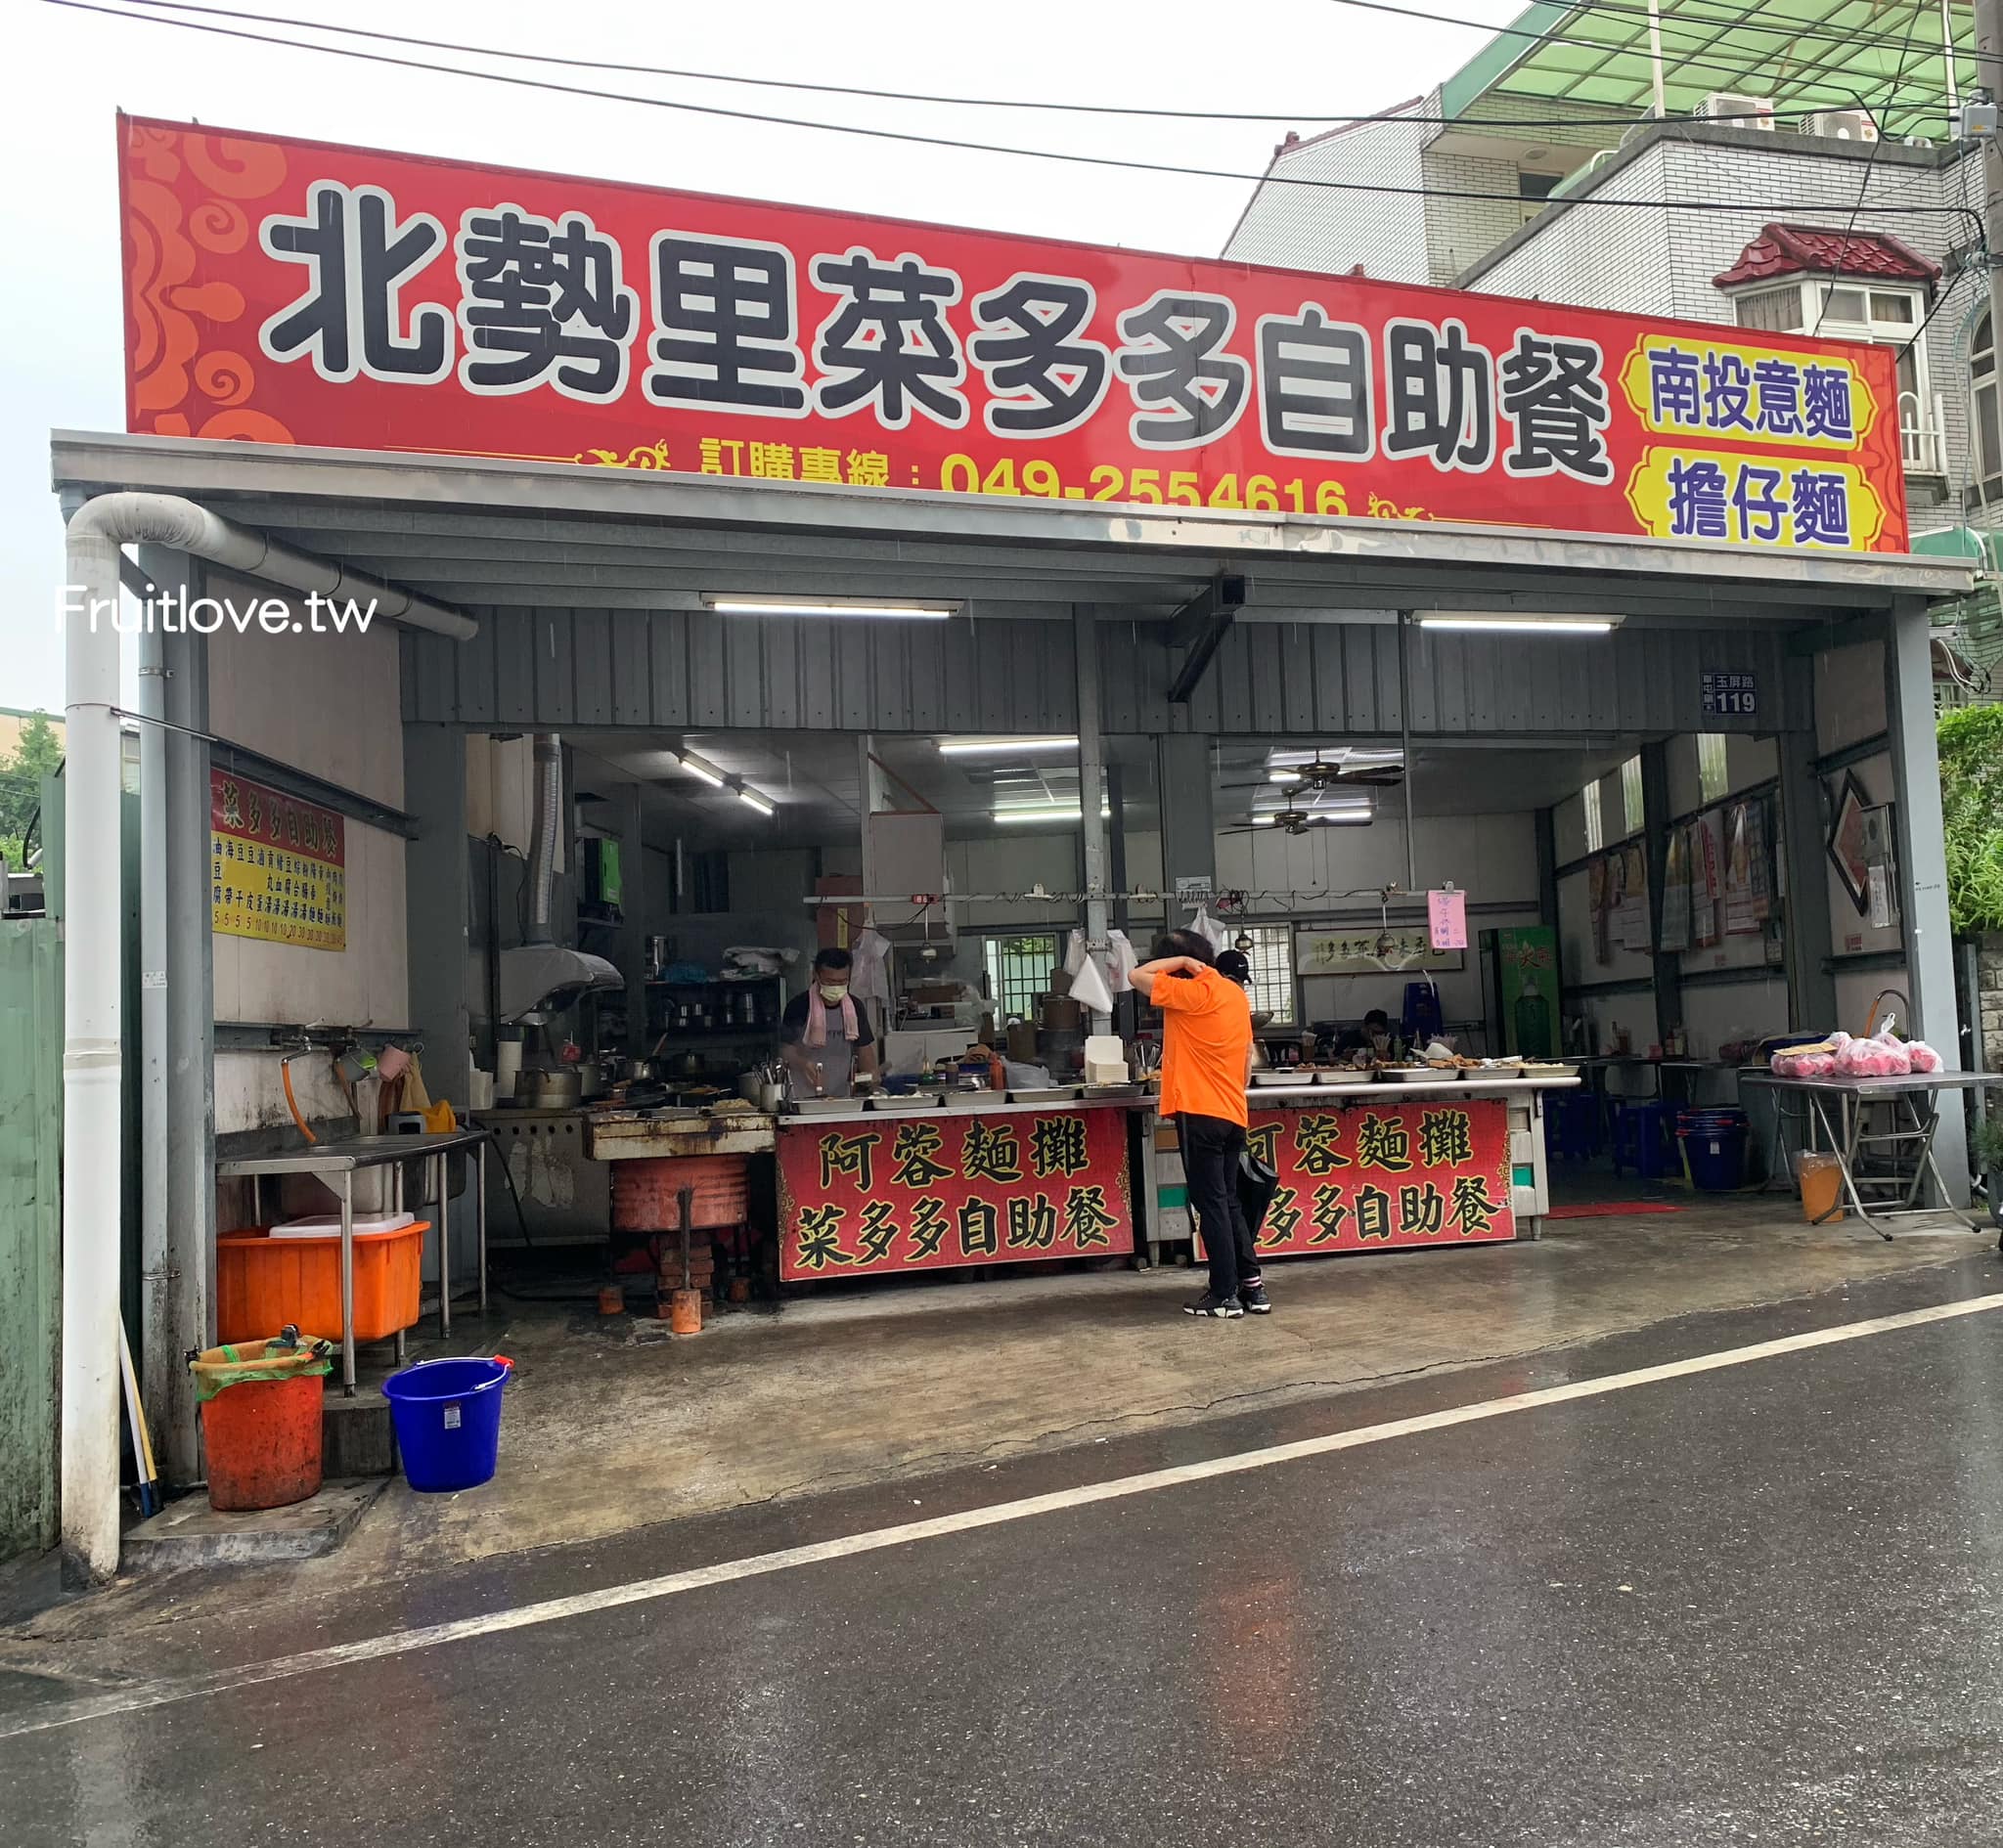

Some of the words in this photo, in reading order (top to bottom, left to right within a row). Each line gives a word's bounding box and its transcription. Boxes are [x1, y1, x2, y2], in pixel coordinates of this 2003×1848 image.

[258, 179, 1615, 485] 北勢里菜多多自助餐
[1647, 345, 1854, 442] 南投意麵
[939, 453, 1350, 517] 049-2554616
[1667, 457, 1850, 546] 擔仔麵
[1716, 692, 1756, 712] 119
[819, 1115, 1091, 1194] 阿蓉麵攤
[793, 1184, 1120, 1269] 菜多多自助餐
[1254, 1174, 1502, 1249] 多多自助餐
